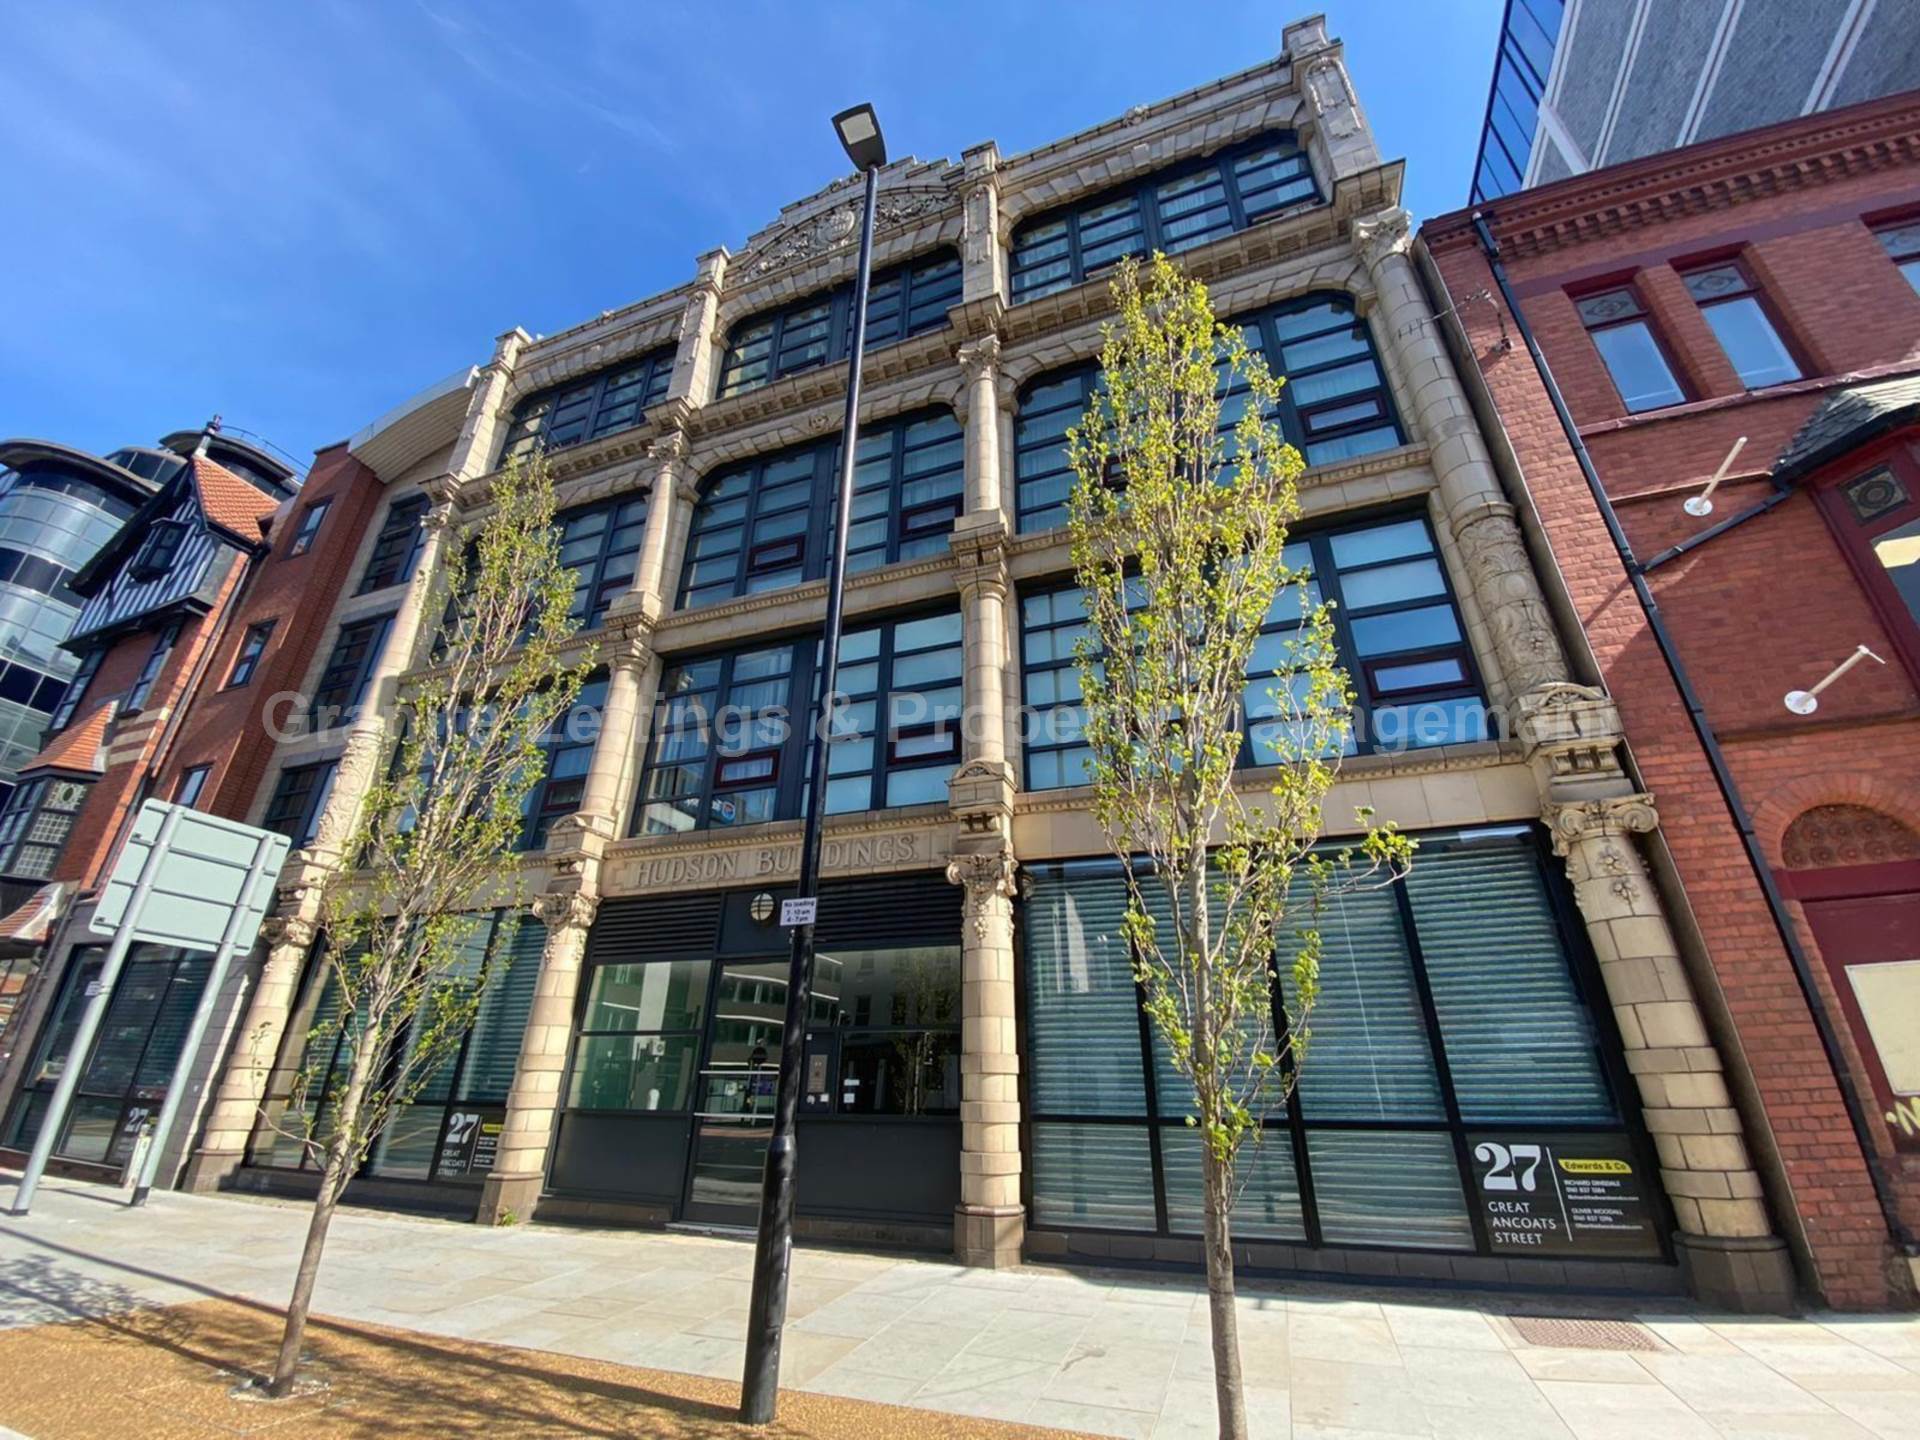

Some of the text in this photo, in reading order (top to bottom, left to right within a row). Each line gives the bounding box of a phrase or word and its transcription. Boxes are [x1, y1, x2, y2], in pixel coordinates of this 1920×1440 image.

[638, 852, 738, 886] HUDSON
[445, 1112, 479, 1144] 27
[1474, 1142, 1541, 1192] 27
[1564, 1161, 1626, 1170] Edwards & Co
[1488, 1201, 1530, 1213] GREAT
[1492, 1217, 1557, 1230] ANCOATS
[1495, 1232, 1542, 1244] STREET
